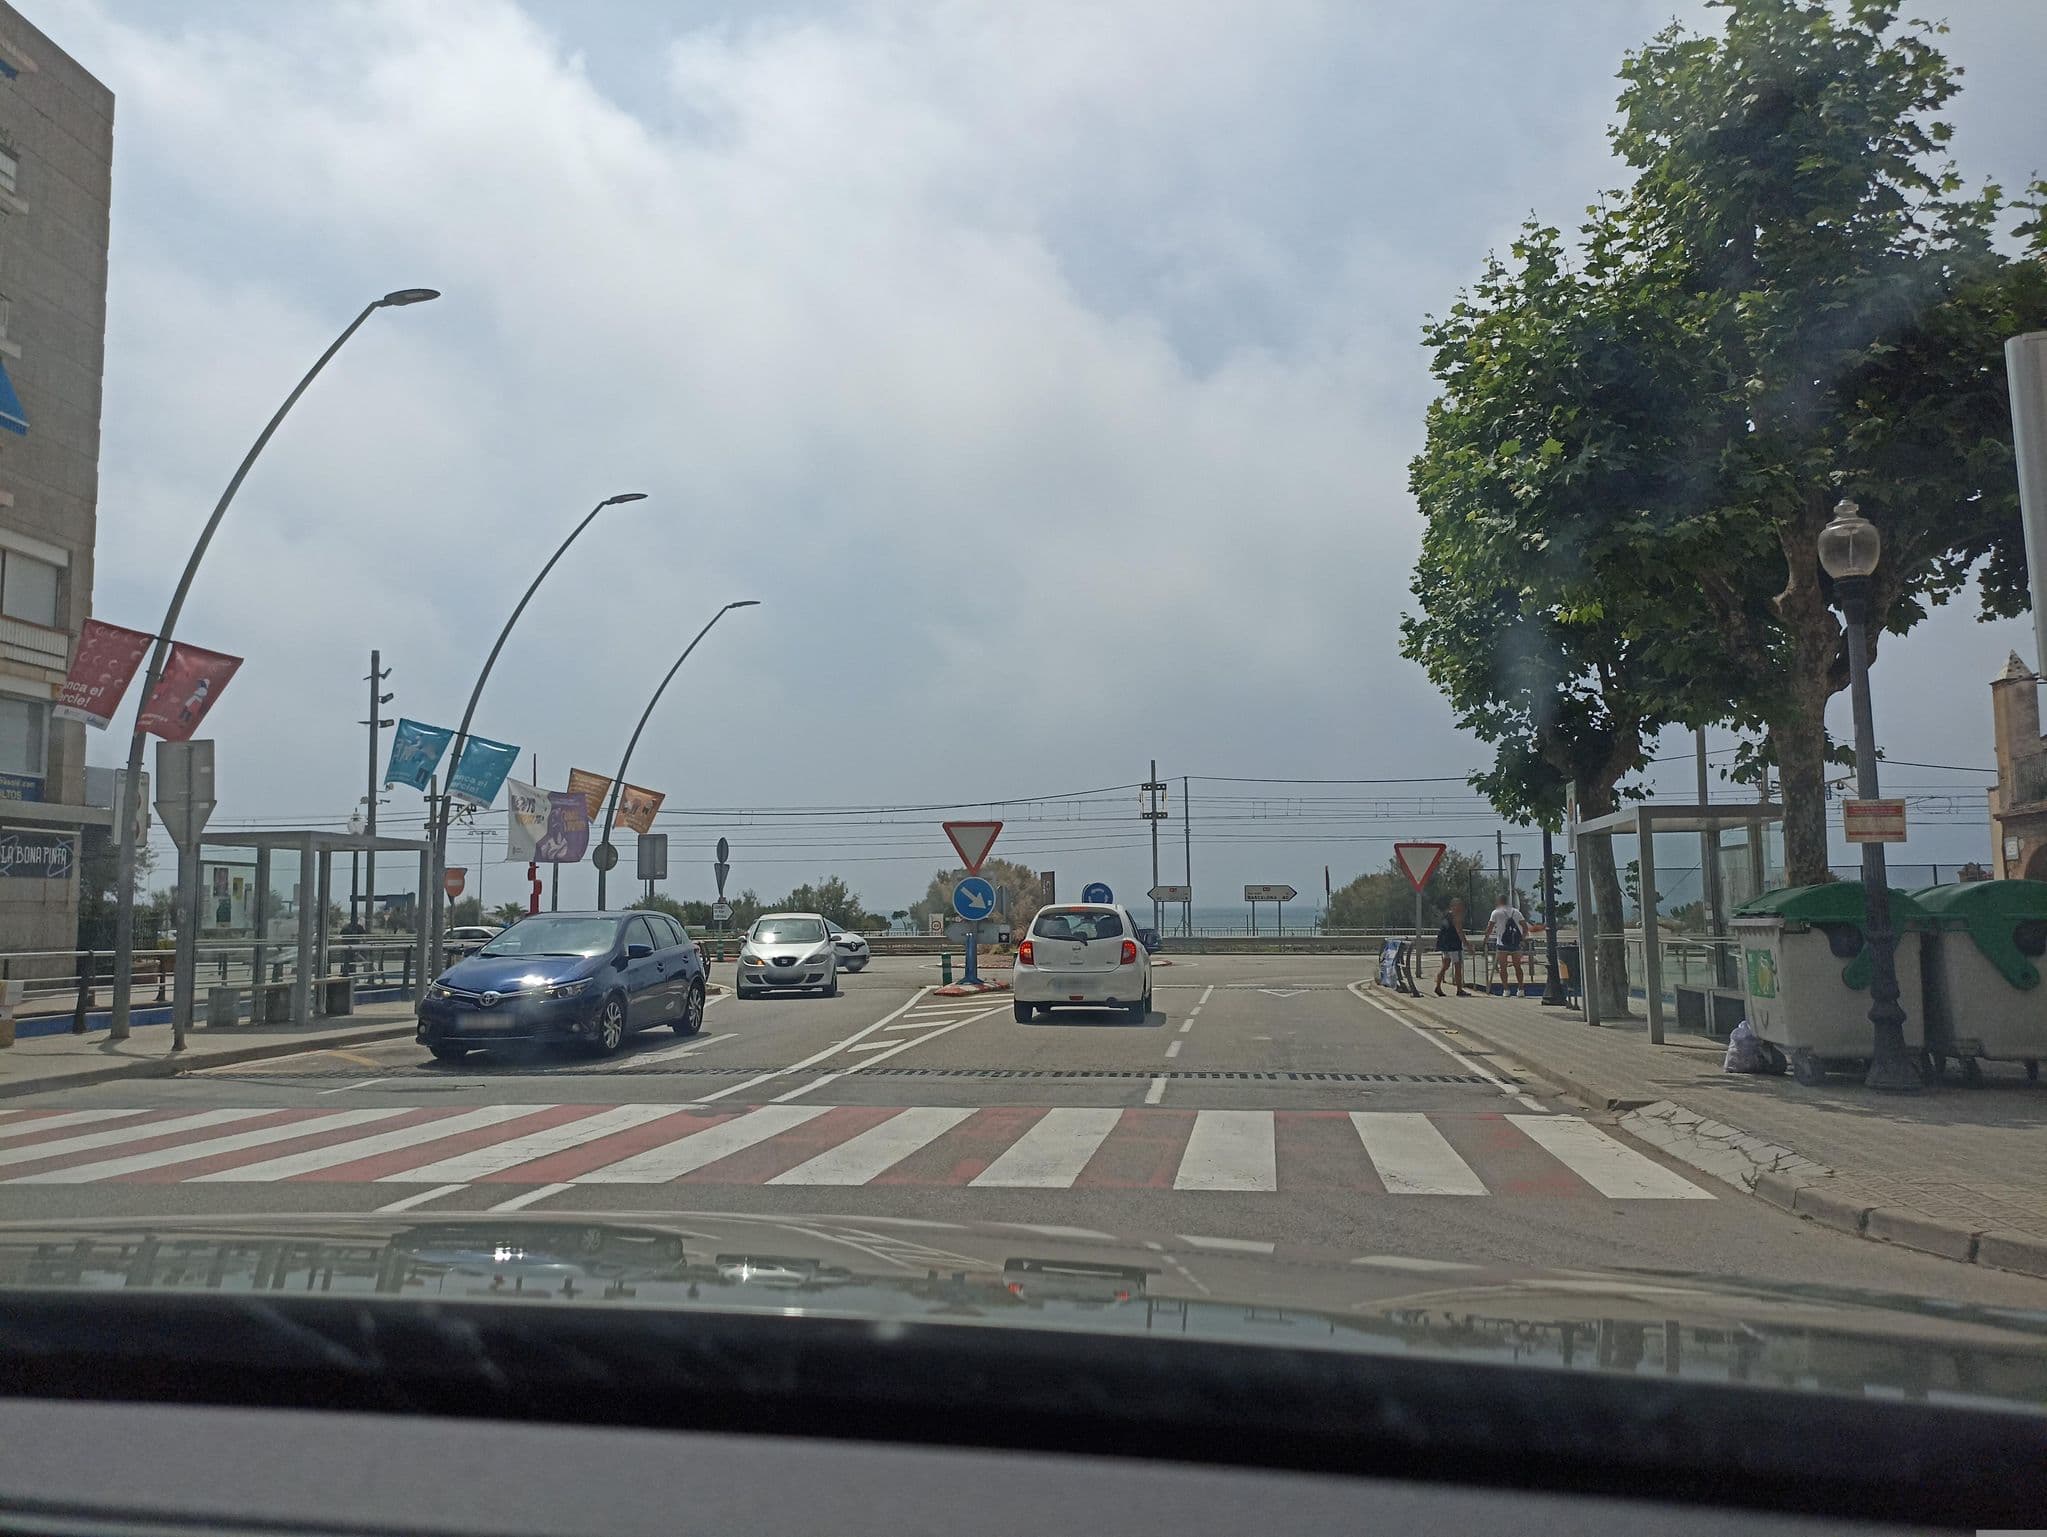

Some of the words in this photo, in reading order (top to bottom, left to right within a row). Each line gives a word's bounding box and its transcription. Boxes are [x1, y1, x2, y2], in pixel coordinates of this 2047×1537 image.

[89, 686, 105, 697] el
[1, 845, 14, 864] LA
[16, 846, 42, 864] BONA
[43, 846, 68, 864] PINTA
